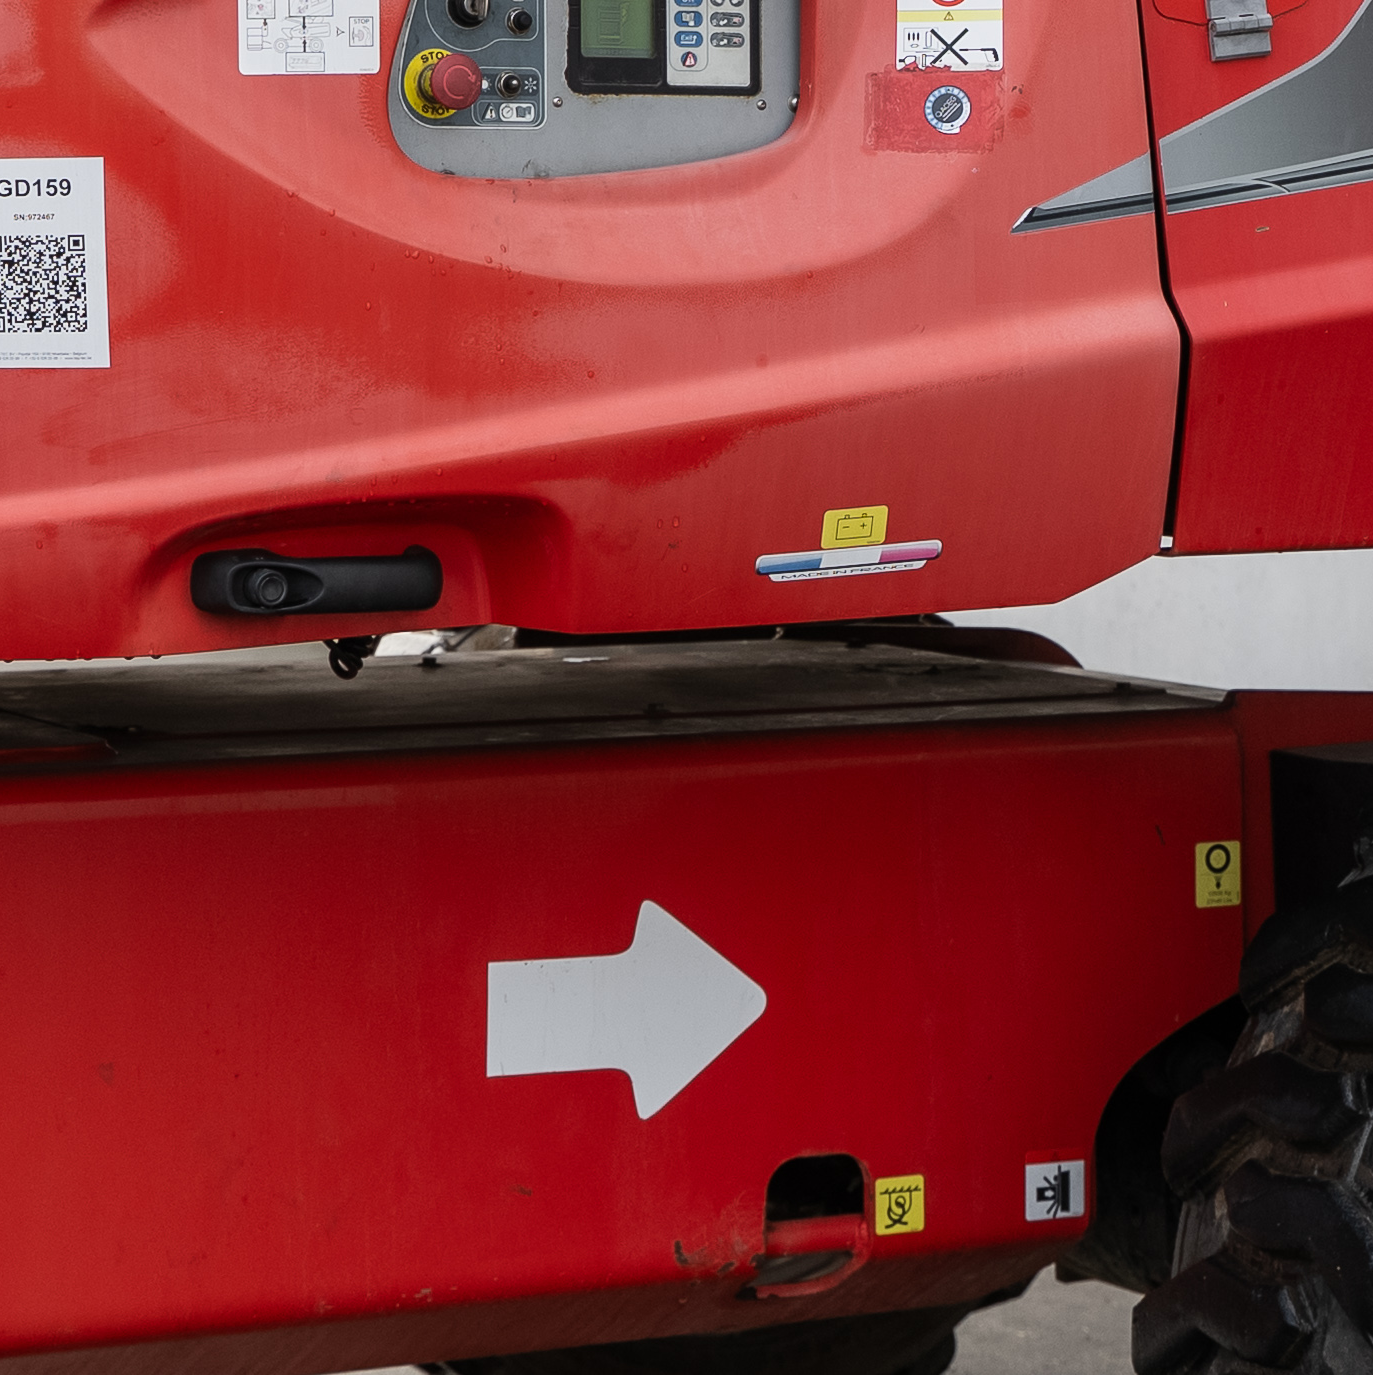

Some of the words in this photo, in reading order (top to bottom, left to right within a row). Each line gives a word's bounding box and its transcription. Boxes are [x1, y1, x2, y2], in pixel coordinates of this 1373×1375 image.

[420, 51, 451, 64] STO
[422, 103, 449, 116] STO
[781, 570, 830, 580] MADE
[850, 563, 914, 574] FRANCE
